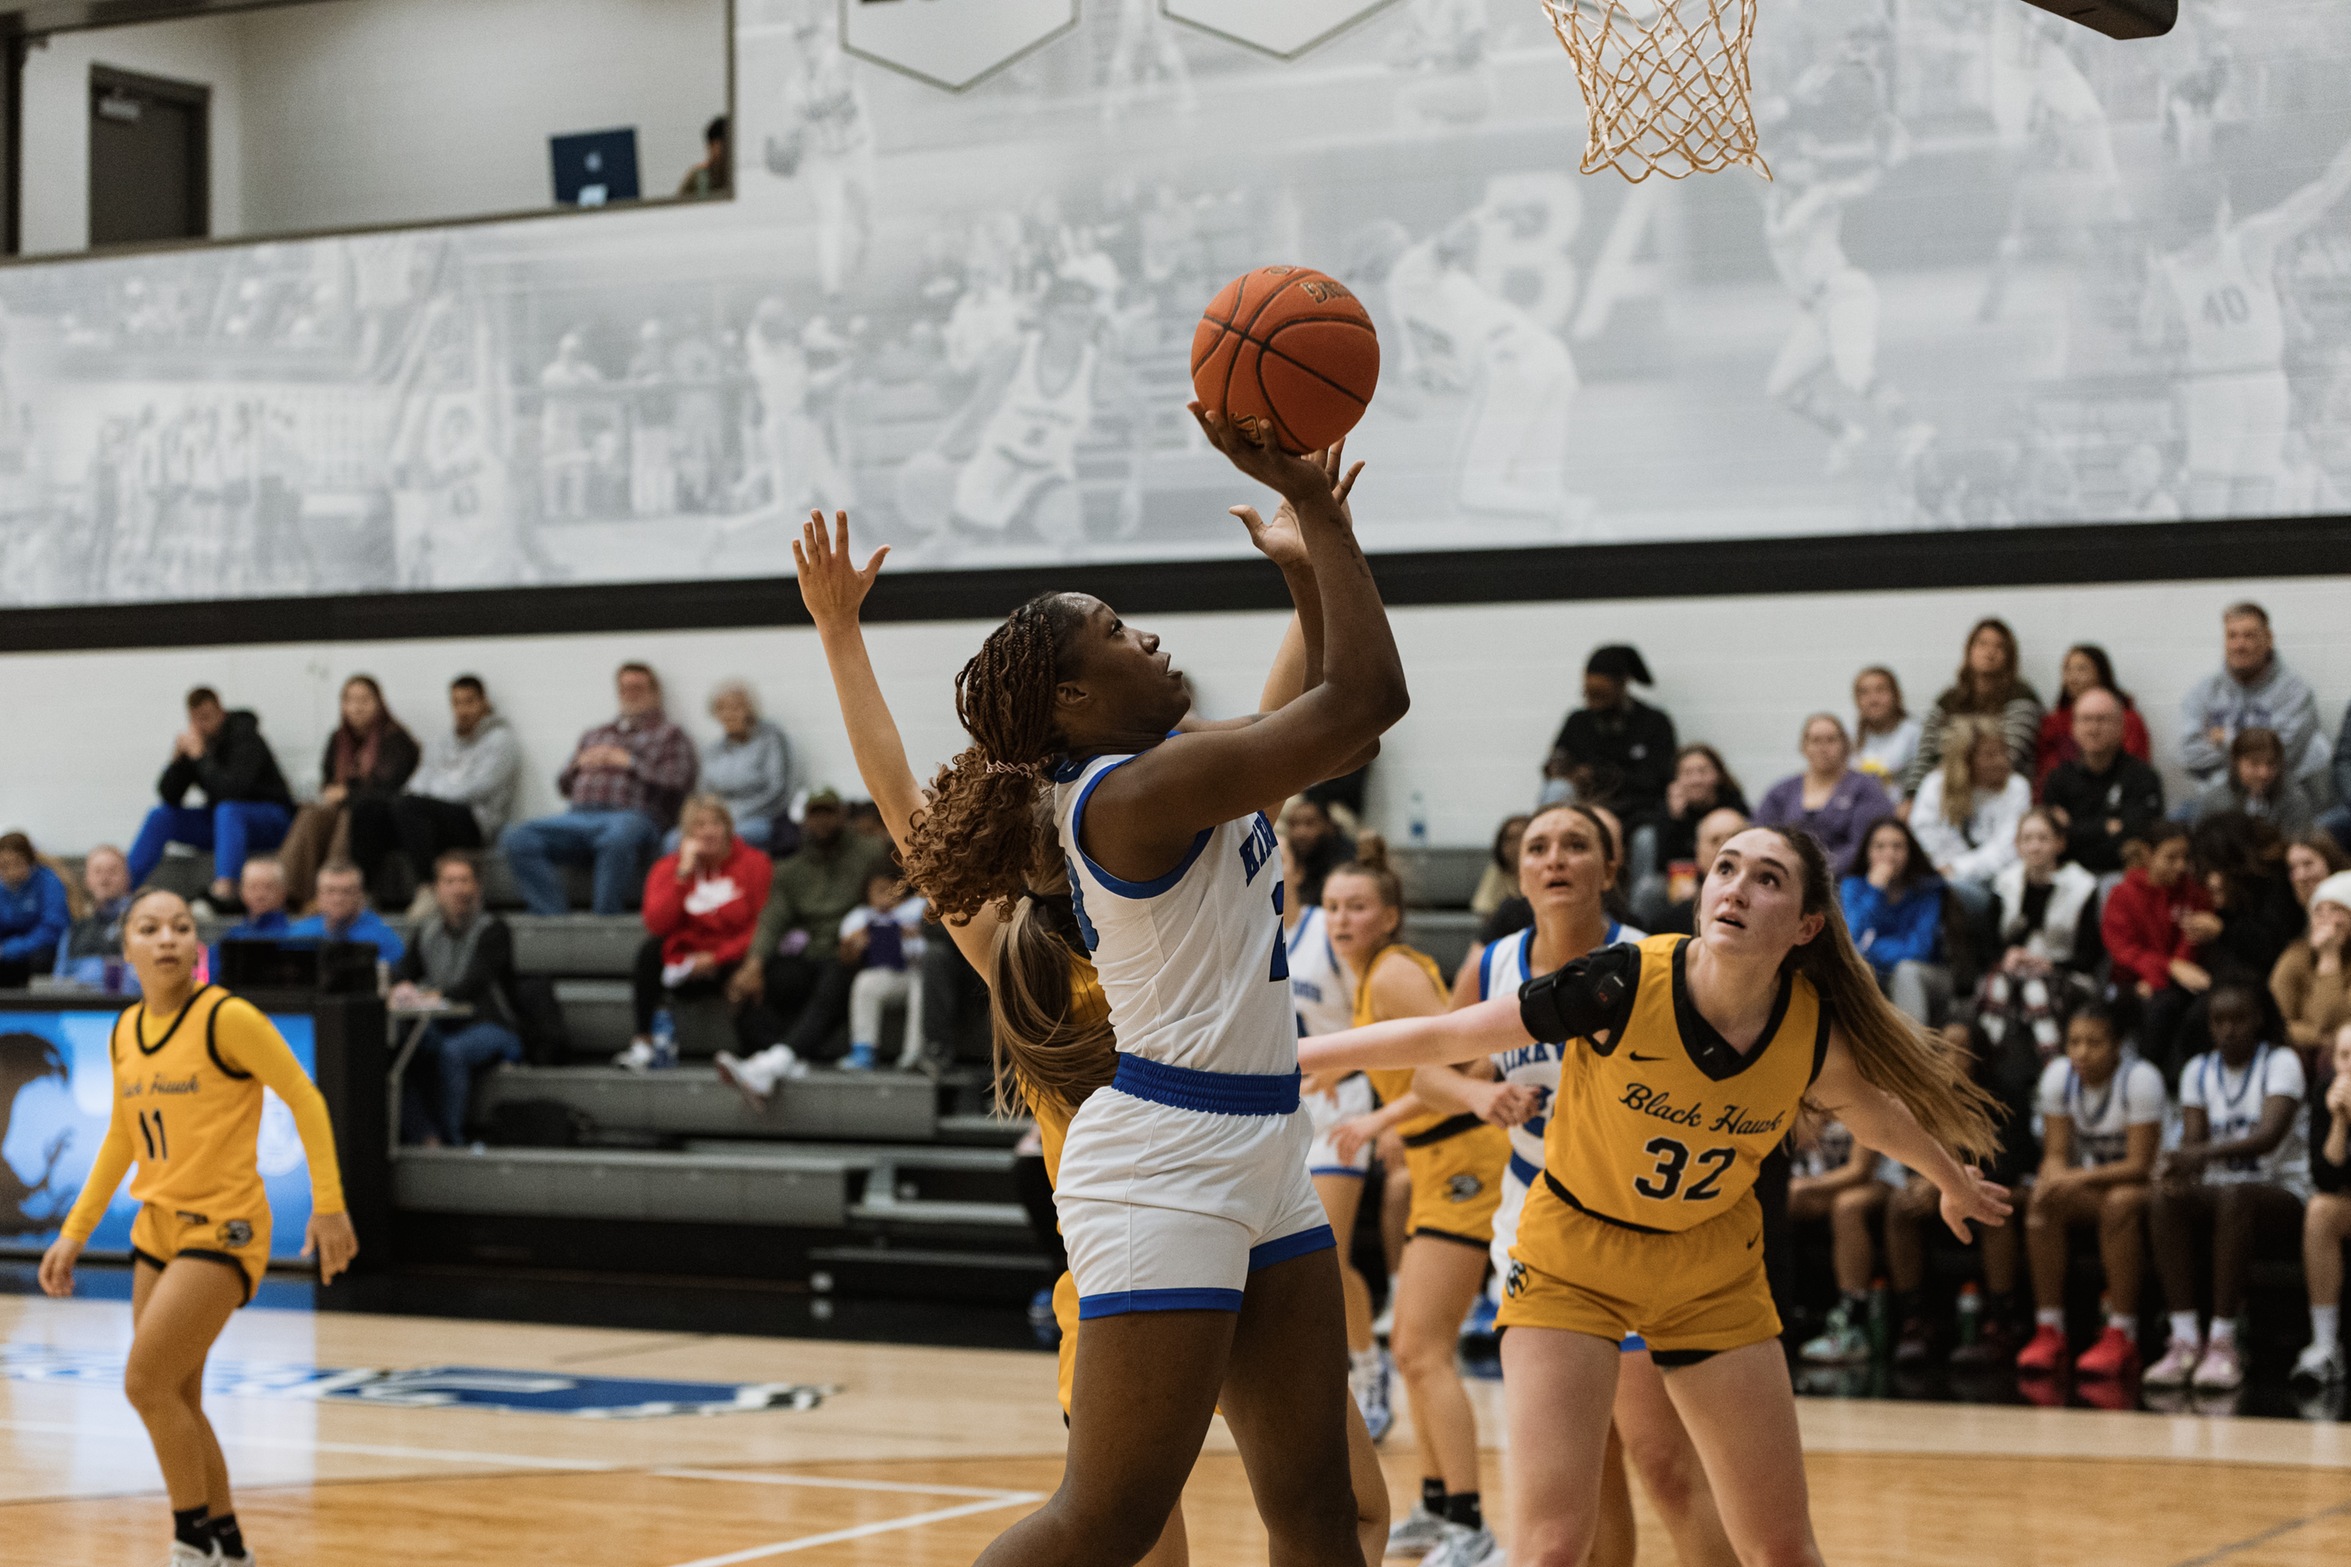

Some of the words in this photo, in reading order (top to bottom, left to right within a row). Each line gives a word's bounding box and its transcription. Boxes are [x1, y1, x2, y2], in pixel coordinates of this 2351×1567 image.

[139, 1109, 167, 1161] 11
[1618, 1082, 1702, 1127] Black
[1708, 1104, 1786, 1135] Hawk
[1633, 1136, 1737, 1201] 32
